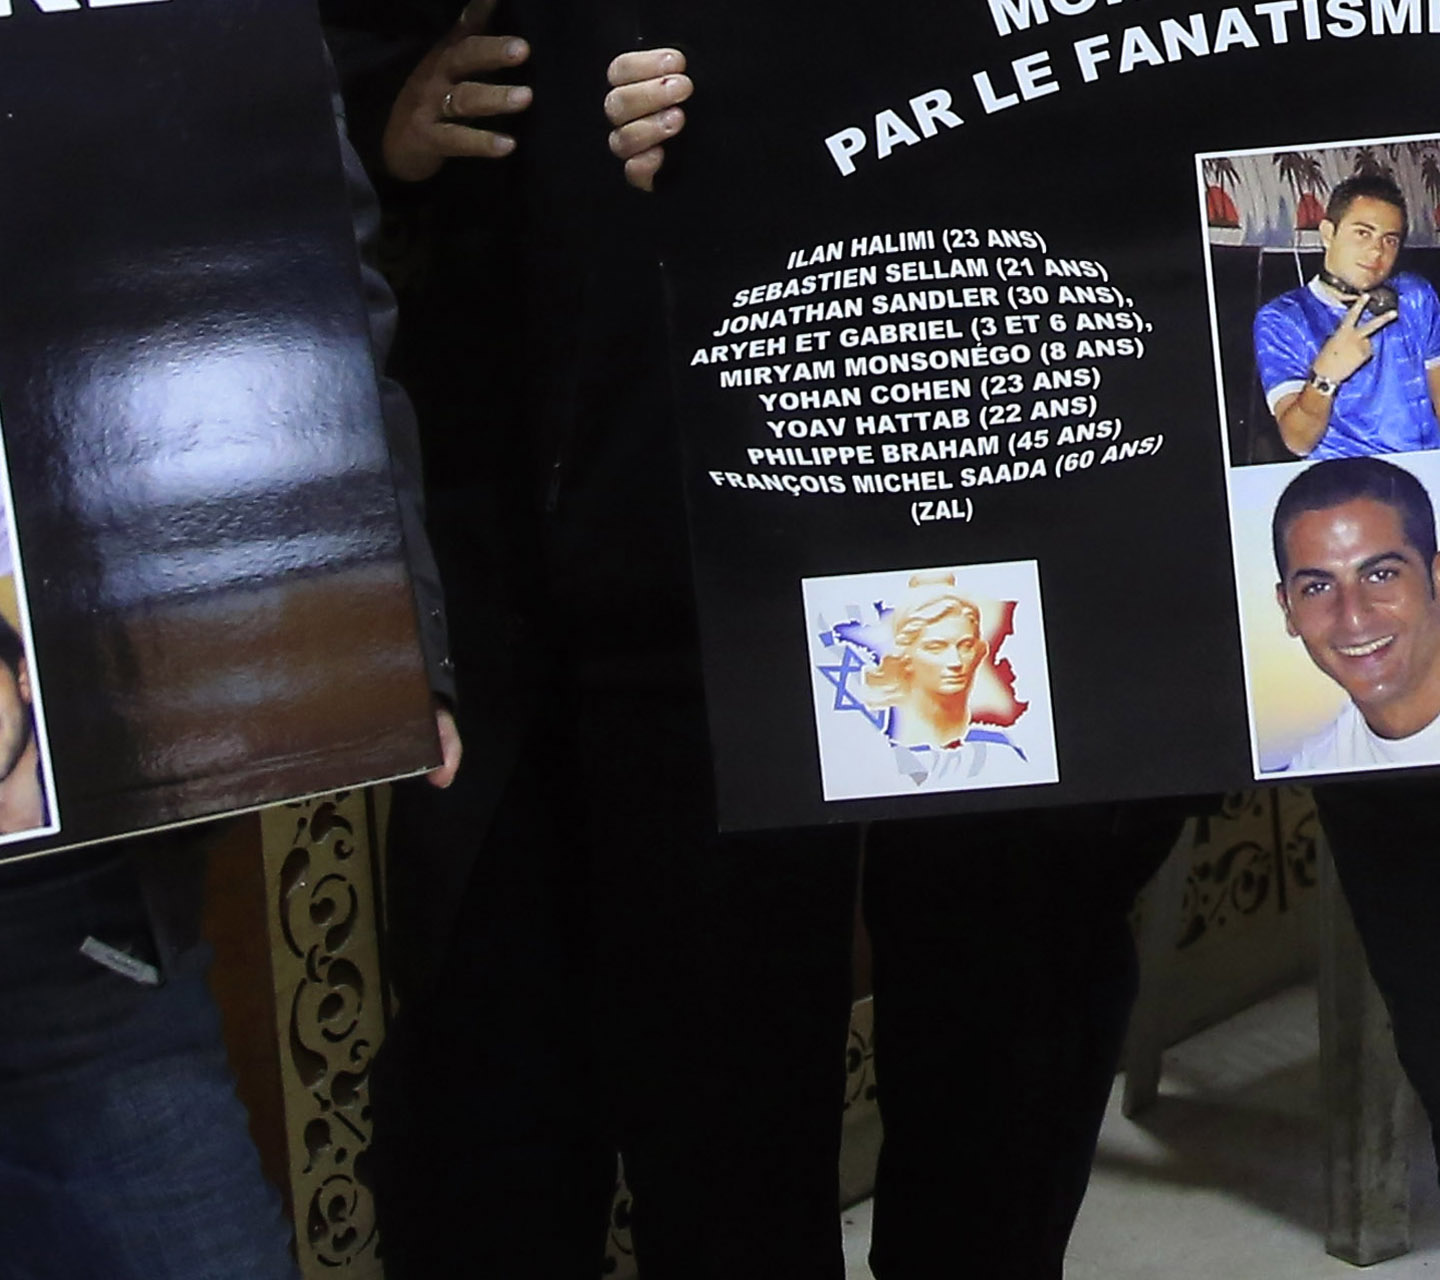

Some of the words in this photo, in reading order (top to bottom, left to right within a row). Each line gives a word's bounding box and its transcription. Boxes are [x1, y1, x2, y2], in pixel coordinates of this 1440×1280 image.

[825, 90, 964, 176] PAR
[973, 51, 1059, 114] LE
[788, 241, 843, 269] ILAN
[851, 230, 934, 257] HALIMI
[943, 229, 979, 253] (23
[988, 230, 1046, 253] ANS)
[733, 266, 876, 307] SEBASTIEN
[886, 258, 988, 282] SELLAM
[997, 258, 1034, 281] (21
[1046, 259, 1108, 282] ANS)
[714, 298, 862, 336] JONATHAN
[873, 288, 999, 314] SANDLER
[1008, 286, 1048, 309] (30
[1059, 286, 1133, 307] ANS),
[691, 337, 785, 365] ARYEH
[796, 331, 830, 352] ET
[840, 320, 962, 347] GABRIEL
[972, 318, 996, 341] (3
[1005, 315, 1040, 334] ET
[1050, 314, 1066, 331] 6
[1076, 312, 1152, 332] ANS),
[721, 360, 834, 387] MIRYAM
[845, 345, 1030, 376] MONSONÉGO
[1041, 342, 1066, 365] (8
[1076, 338, 1143, 358] ANS)
[759, 388, 861, 411] YOHAN
[871, 379, 970, 404] COHEN
[981, 375, 1023, 400] (23
[1033, 367, 1100, 390] ANS)
[767, 418, 845, 438] YOAV
[856, 409, 970, 434] HATTAB
[980, 404, 1021, 430] (22
[1030, 396, 1096, 420] ANS)
[709, 472, 846, 496] FRANÇOIS
[852, 471, 953, 492] MICHEL
[961, 459, 1046, 486] SAADA
[1056, 450, 1094, 478] (60
[1101, 435, 1162, 464] ANS)
[748, 446, 874, 465] PHILIPPE
[882, 436, 998, 462] BRAHAM
[1009, 430, 1048, 456] (45
[1057, 419, 1121, 445] ANS)
[912, 498, 972, 525] (ZAL)
